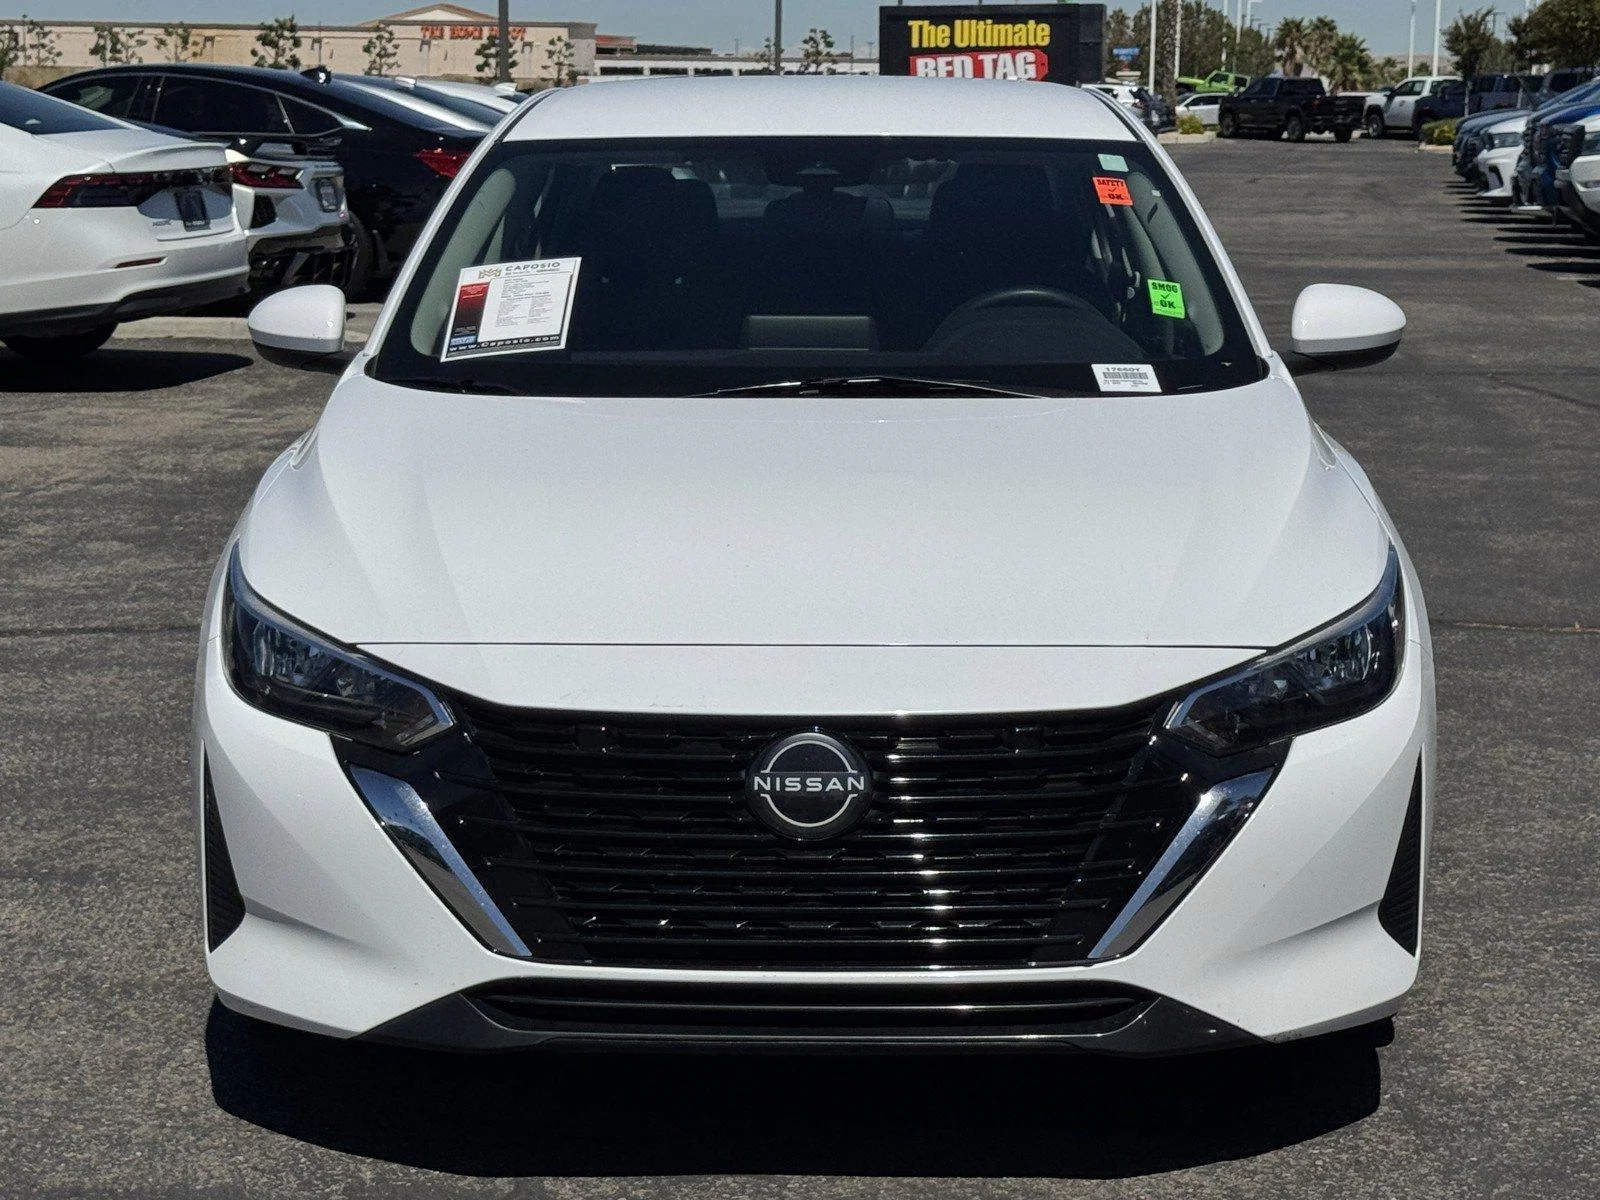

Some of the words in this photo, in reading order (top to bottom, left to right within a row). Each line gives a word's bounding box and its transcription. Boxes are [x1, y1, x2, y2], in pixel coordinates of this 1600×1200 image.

[908, 20, 951, 48] The
[954, 19, 1051, 47] Ultimate
[916, 55, 974, 79] RED
[978, 51, 1037, 80] TAG
[1096, 179, 1125, 188] SAFETY
[505, 261, 561, 272] CAPOSIO
[1151, 282, 1178, 294] SMOG
[1159, 299, 1177, 309] OK
[449, 335, 560, 352] www.Caposio.com
[753, 776, 865, 792] NISSAN
